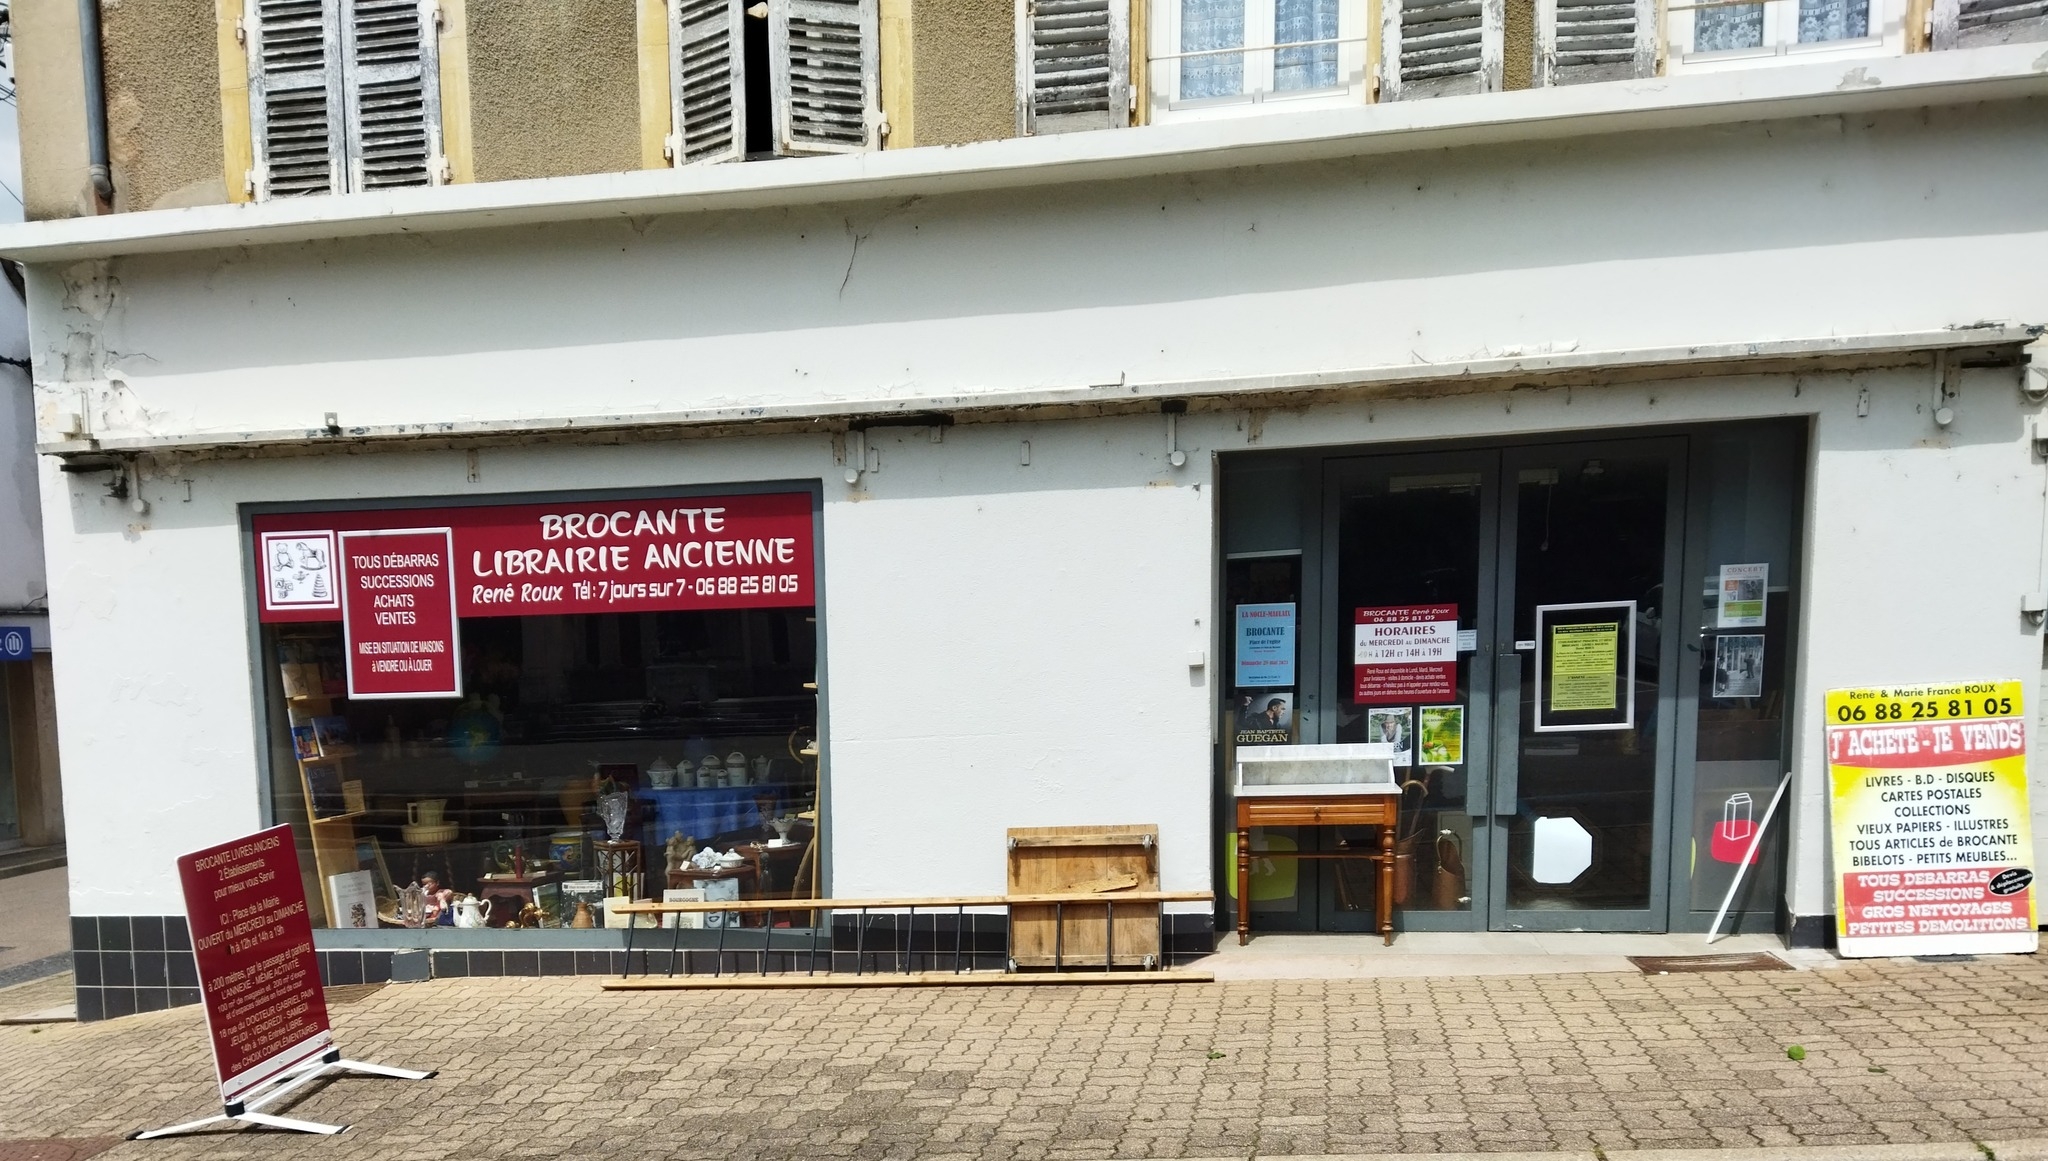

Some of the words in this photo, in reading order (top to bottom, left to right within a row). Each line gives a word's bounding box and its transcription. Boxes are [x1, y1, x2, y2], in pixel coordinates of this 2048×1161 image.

[539, 507, 726, 540] BROCANTE
[352, 555, 381, 569] TOUS
[383, 552, 439, 568] DÉBARRAS
[472, 545, 630, 577] LIBRAIRIE
[644, 537, 796, 569] ANCIENNE
[360, 574, 434, 589] SUCCESSIONS
[471, 583, 514, 605] René
[521, 582, 563, 603] Roux
[598, 581, 608, 599] 7
[608, 579, 646, 604] jours
[649, 581, 673, 598] sur
[676, 578, 685, 596] 7
[695, 577, 715, 595] 06
[718, 576, 738, 595] 88
[740, 575, 759, 594] 25
[762, 574, 776, 593] 81
[779, 574, 798, 593] 05
[373, 594, 415, 608] ACHATS
[375, 611, 416, 625] VENTES
[1363, 609, 1410, 617] BROCANTE
[1412, 608, 1430, 616] René
[1246, 627, 1285, 637] BROCANTE
[1374, 625, 1436, 637] HORAIRES
[359, 642, 373, 654] MISE
[373, 642, 381, 654] EN
[381, 641, 410, 654] SITUATION
[410, 641, 418, 653] DE
[418, 640, 444, 653] MAISONS
[1368, 638, 1404, 647] MERCREDI
[1414, 637, 1450, 645] DIMANCHE
[1381, 649, 1395, 657] 12H
[1406, 648, 1420, 657] 14H
[1428, 647, 1442, 656] 19H
[376, 660, 399, 672] VENDRE
[399, 660, 407, 671] OU
[413, 659, 432, 671] LOUER
[1850, 690, 1875, 700] René
[1881, 689, 1888, 698] &
[1894, 688, 1924, 698] Marie
[1927, 686, 1961, 696] France
[1965, 684, 1996, 694] ROUX
[1838, 704, 1866, 722] 06
[1875, 703, 1902, 720] 88
[1911, 701, 1939, 718] 25
[1948, 699, 1973, 717] 81
[1984, 698, 2012, 715] 05
[1236, 734, 1288, 742] GUEGAN
[1847, 727, 1920, 757] ACHETE
[1933, 725, 1954, 755] JE
[1960, 721, 2023, 751] VENDS
[1866, 775, 1903, 788] LIVRES
[1915, 774, 1934, 785] B.D
[1946, 771, 1995, 785] DISQUES
[1881, 790, 1923, 803] CARTES
[1927, 788, 1982, 801] POSTALES
[1894, 804, 1971, 818] COLLECTIONS
[1857, 823, 1892, 835] VIEUX
[1896, 821, 1942, 833] PAPIERS
[1954, 818, 2009, 831] ILLUSTRES
[1849, 839, 1881, 851] TOUS
[1884, 837, 1935, 849] ARTICLES
[1939, 835, 1954, 848] de
[1957, 834, 2018, 847] BROCANTE
[195, 850, 231, 872] BROCANTE
[231, 844, 254, 861] LIVRES
[253, 836, 280, 853] ANCIENS
[1853, 854, 1905, 867] BIBELOTS
[1916, 853, 1952, 865] PETITS
[1955, 850, 2018, 863] MEUBLES...
[218, 869, 224, 880] 2
[224, 858, 265, 879] Établissements
[2002, 871, 2018, 880] Devis
[214, 886, 228, 902] pour
[228, 881, 245, 896] mieux
[245, 877, 259, 890] vous
[259, 869, 275, 883] Servir
[1857, 873, 1901, 888] TOUS
[1904, 870, 1990, 886] DEBARRAS
[1873, 887, 1985, 903] SUCCESSIONS
[220, 913, 230, 926] ICI
[232, 907, 249, 921] Place
[248, 904, 257, 916] de
[256, 901, 263, 912] la
[262, 895, 280, 910] Mairie
[1862, 904, 1905, 919] GROS
[1908, 901, 2013, 918] NETTOYAGES
[198, 930, 225, 951] OUVERT
[225, 927, 234, 940] du
[233, 915, 266, 937] MERCREDI
[266, 913, 274, 924] au
[274, 901, 304, 922] DIMANCHE
[1848, 920, 1915, 935] PETITES
[1918, 917, 2029, 933] DEMOLITIONS
[240, 937, 252, 951] 12h
[251, 934, 259, 946] et
[258, 928, 269, 943] 14h
[273, 924, 285, 938] 19h
[208, 981, 213, 993] à
[212, 978, 225, 991] 200
[246, 966, 257, 980] par
[262, 953, 285, 971] passage
[284, 949, 292, 960] et
[291, 942, 311, 960] parking
[218, 1003, 228, 1013] 100
[243, 988, 265, 1004] magasin
[273, 979, 283, 989] 200
[220, 979, 252, 1000] L'ANNEXE
[220, 1028, 228, 1039] 18
[227, 1024, 238, 1036] rue
[238, 1018, 246, 1031] du
[245, 1006, 275, 1027] DOCTEUR
[275, 993, 302, 1013] GABRIEL
[300, 986, 315, 1003] PAIN
[230, 1030, 249, 1047] JEUDI
[252, 1014, 283, 1036] VENDREDI
[287, 1001, 309, 1020] SAMEDI
[241, 1042, 252, 1055] 14h
[257, 1035, 268, 1049] 19h
[268, 1026, 286, 1042] Entrée
[286, 1016, 304, 1033] LIBRE
[231, 1060, 242, 1073] des
[242, 1049, 262, 1067] CHOIX
[262, 1021, 318, 1058] COMPLÉMENTAIRES
